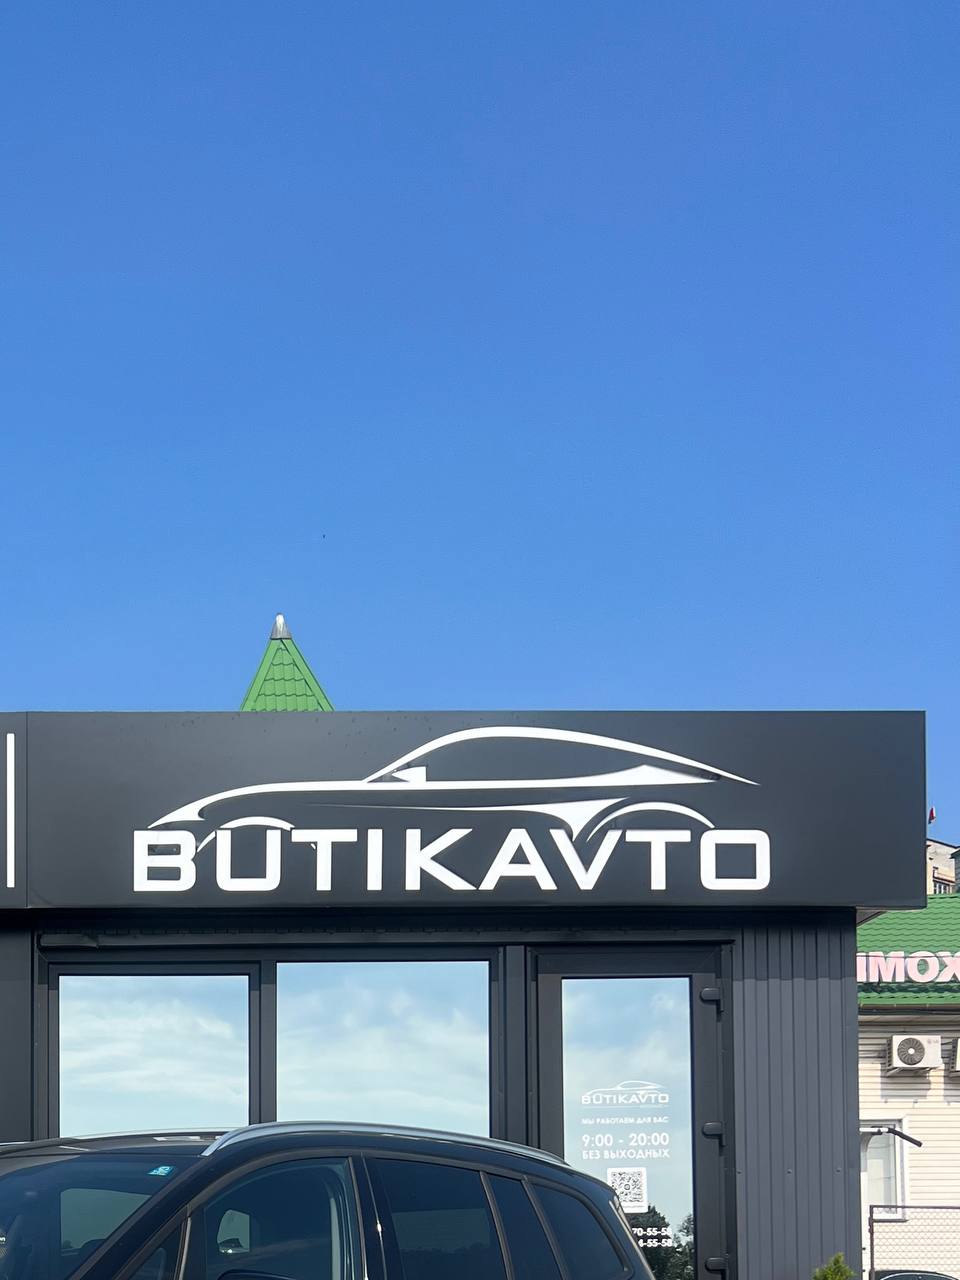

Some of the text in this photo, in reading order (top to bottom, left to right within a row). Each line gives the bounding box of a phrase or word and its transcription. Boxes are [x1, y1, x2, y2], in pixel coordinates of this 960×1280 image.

[133, 827, 772, 893] BUTIKAVTO
[581, 1093, 669, 1105] BUTIKAVTO
[582, 1133, 613, 1147] 9:00
[628, 1132, 669, 1146] 20:00
[582, 1148, 670, 1160] БЕЗ ВЫХОДНЫХ
